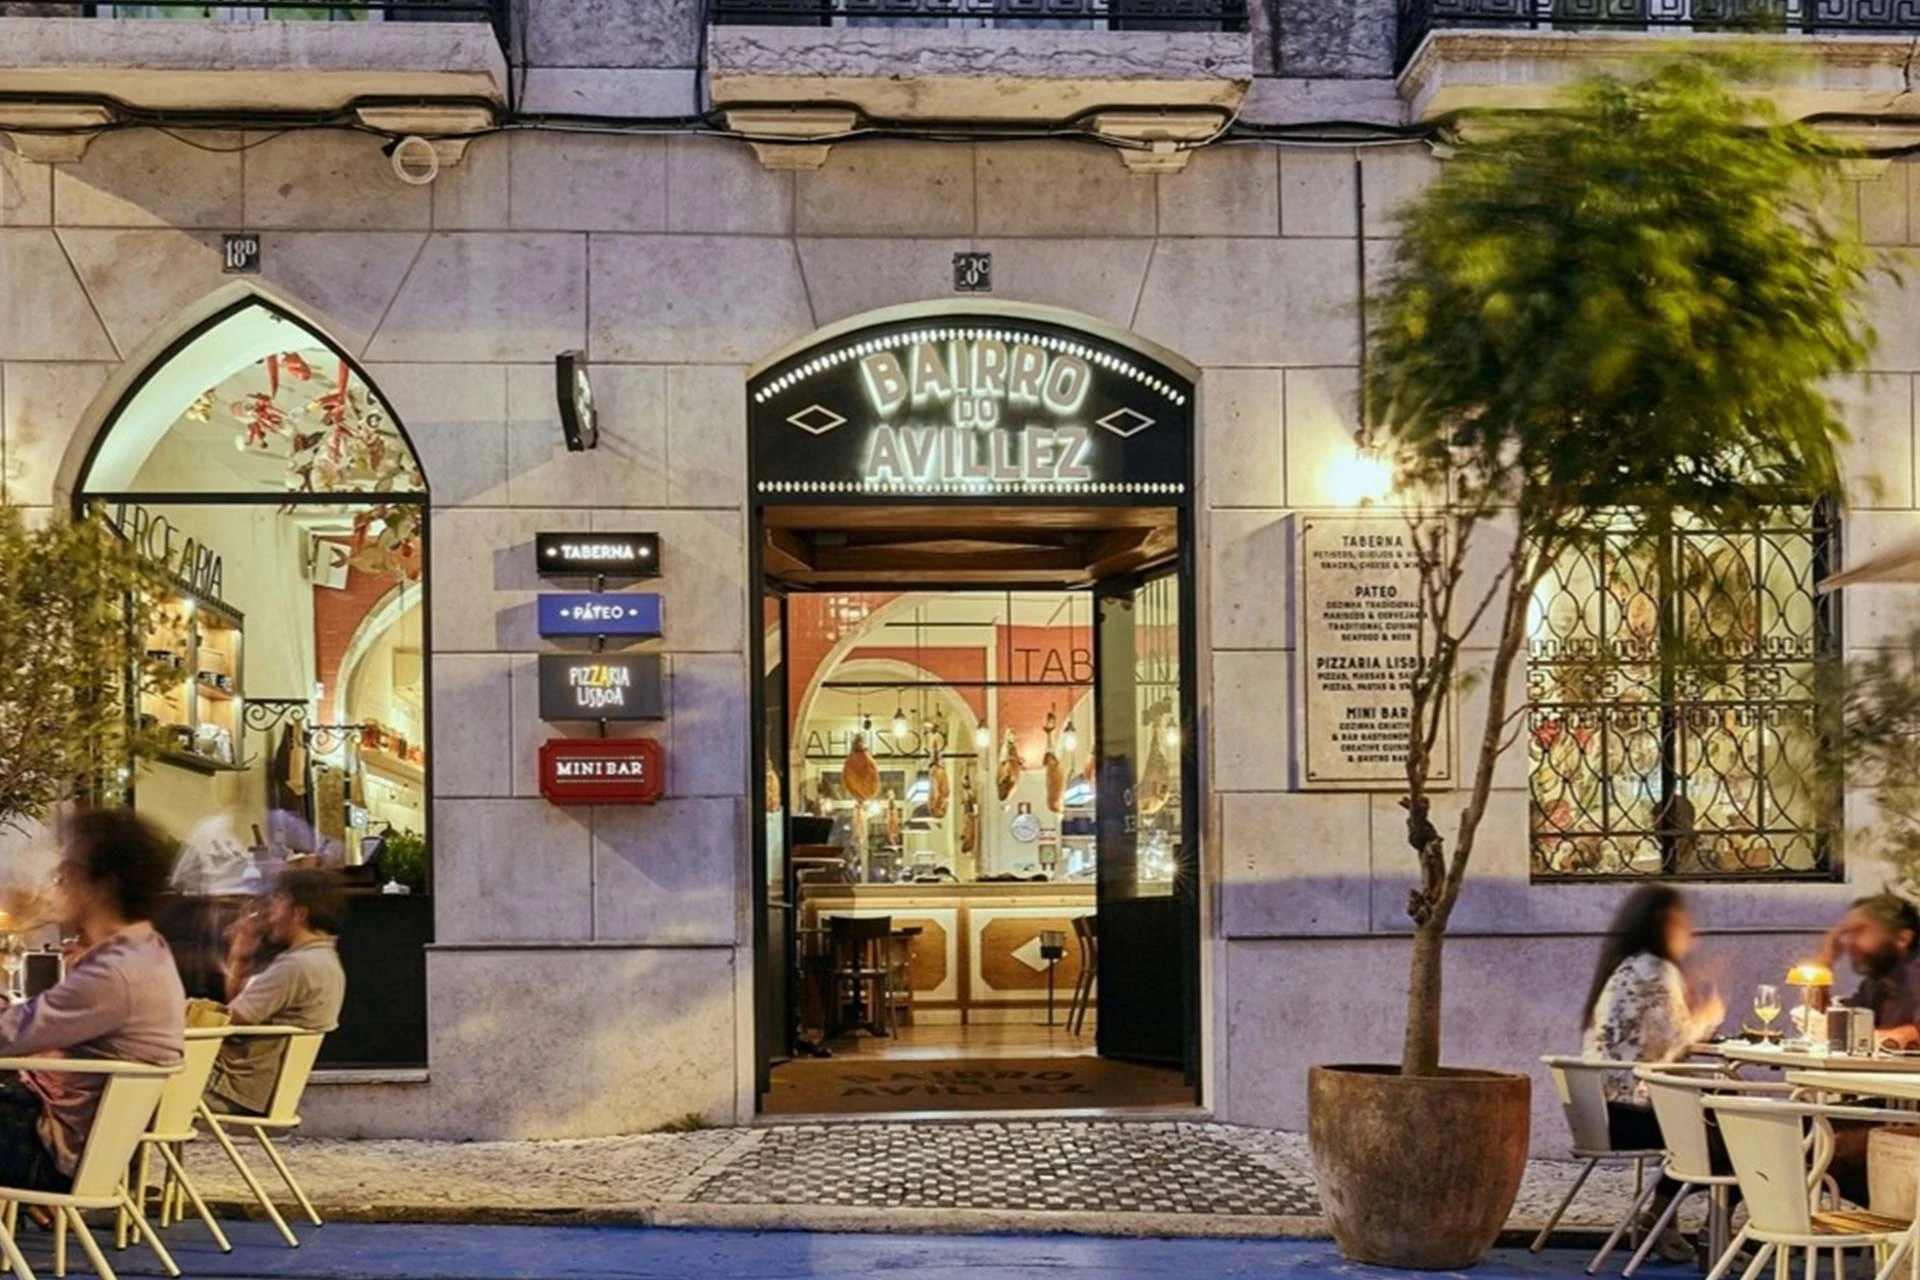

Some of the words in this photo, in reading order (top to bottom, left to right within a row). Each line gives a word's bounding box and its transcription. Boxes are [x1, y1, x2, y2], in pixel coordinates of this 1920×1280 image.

[863, 339, 1090, 415] BAIRRO
[955, 396, 998, 427] DO
[865, 425, 1091, 483] AVILLEZ
[1342, 535, 1403, 547] TABERNA
[561, 544, 634, 559] TABERNA
[573, 602, 624, 620] PÁTEO
[1316, 656, 1381, 669] PIZZARIA
[569, 664, 630, 687] PIZZARIA
[577, 686, 625, 708] LISBOA
[1346, 707, 1376, 719] MINI
[1381, 707, 1409, 719] BAR
[556, 761, 603, 776] MINI
[605, 761, 643, 776] BAR
